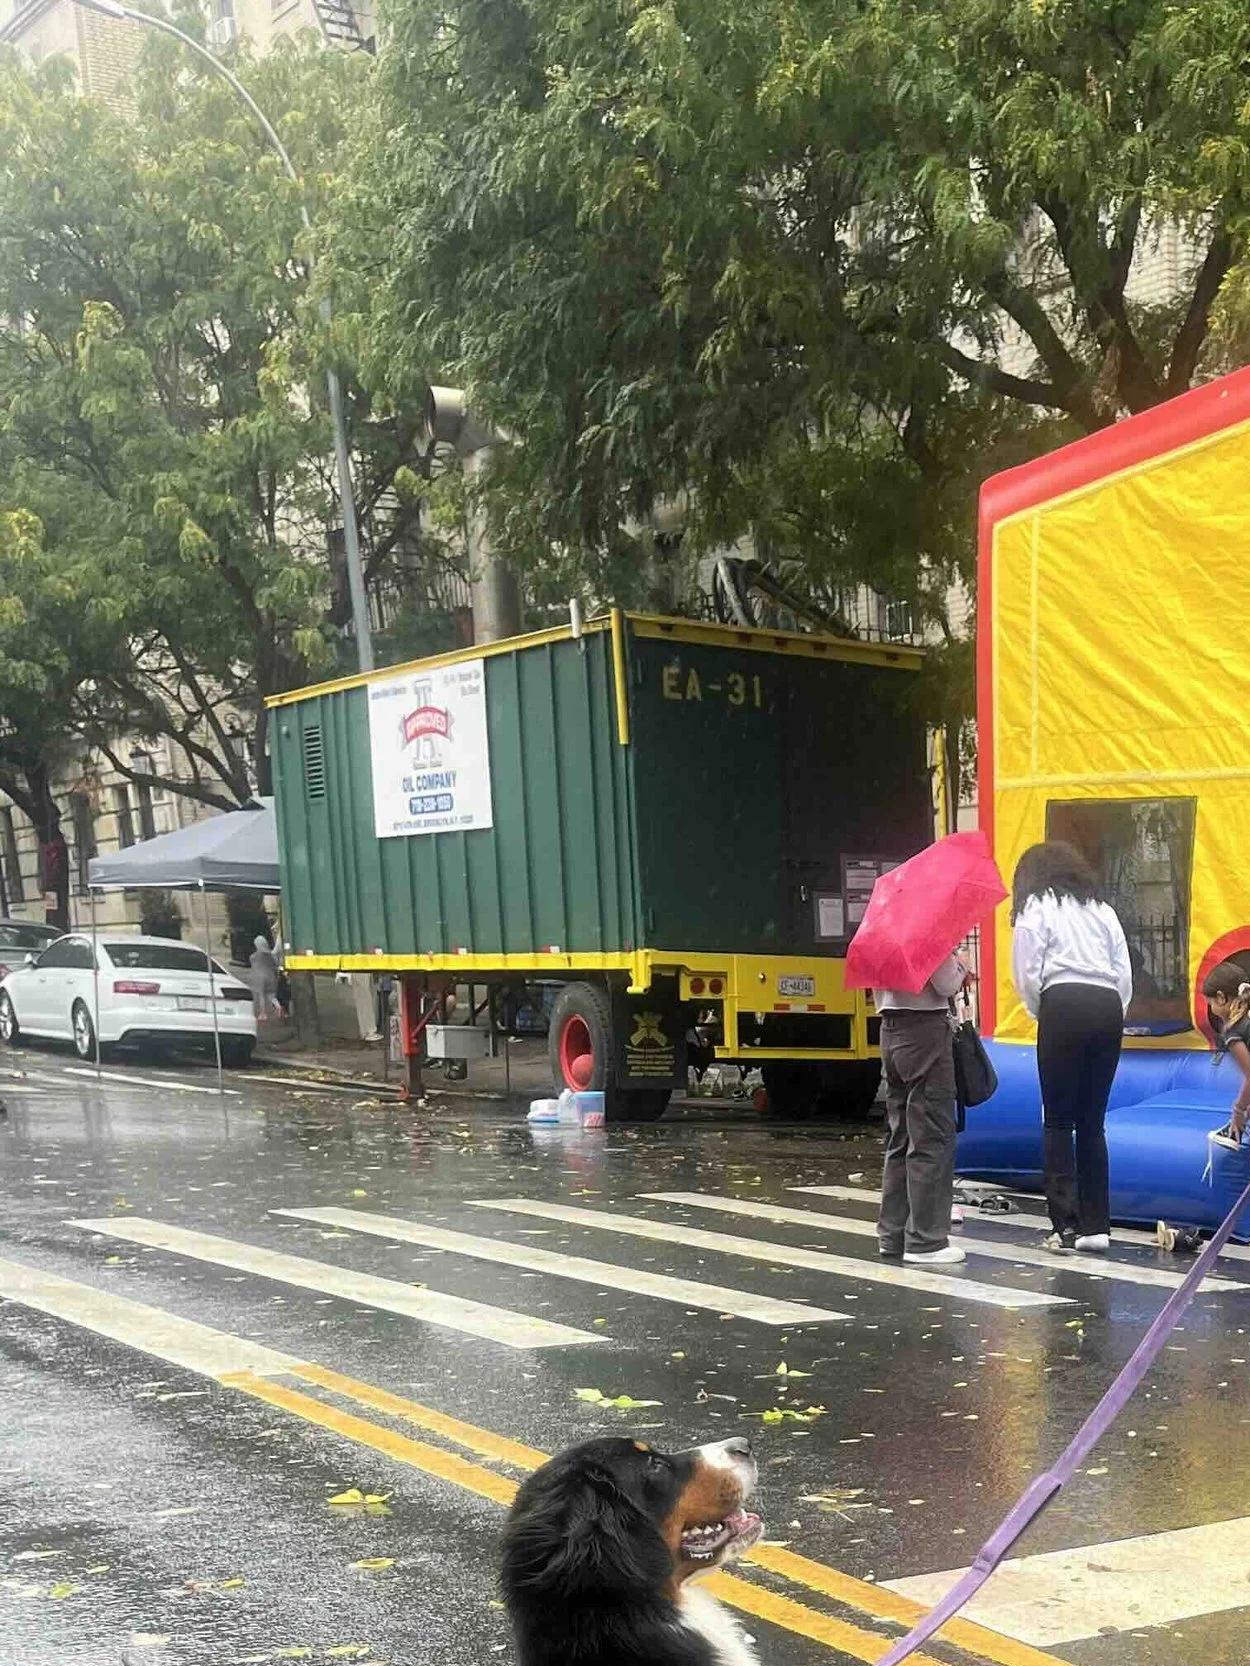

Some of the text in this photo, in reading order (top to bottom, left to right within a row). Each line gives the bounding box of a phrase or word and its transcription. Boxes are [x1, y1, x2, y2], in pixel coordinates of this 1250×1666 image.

[662, 664, 761, 707] EA-31
[403, 770, 457, 793] OIL COMPANY
